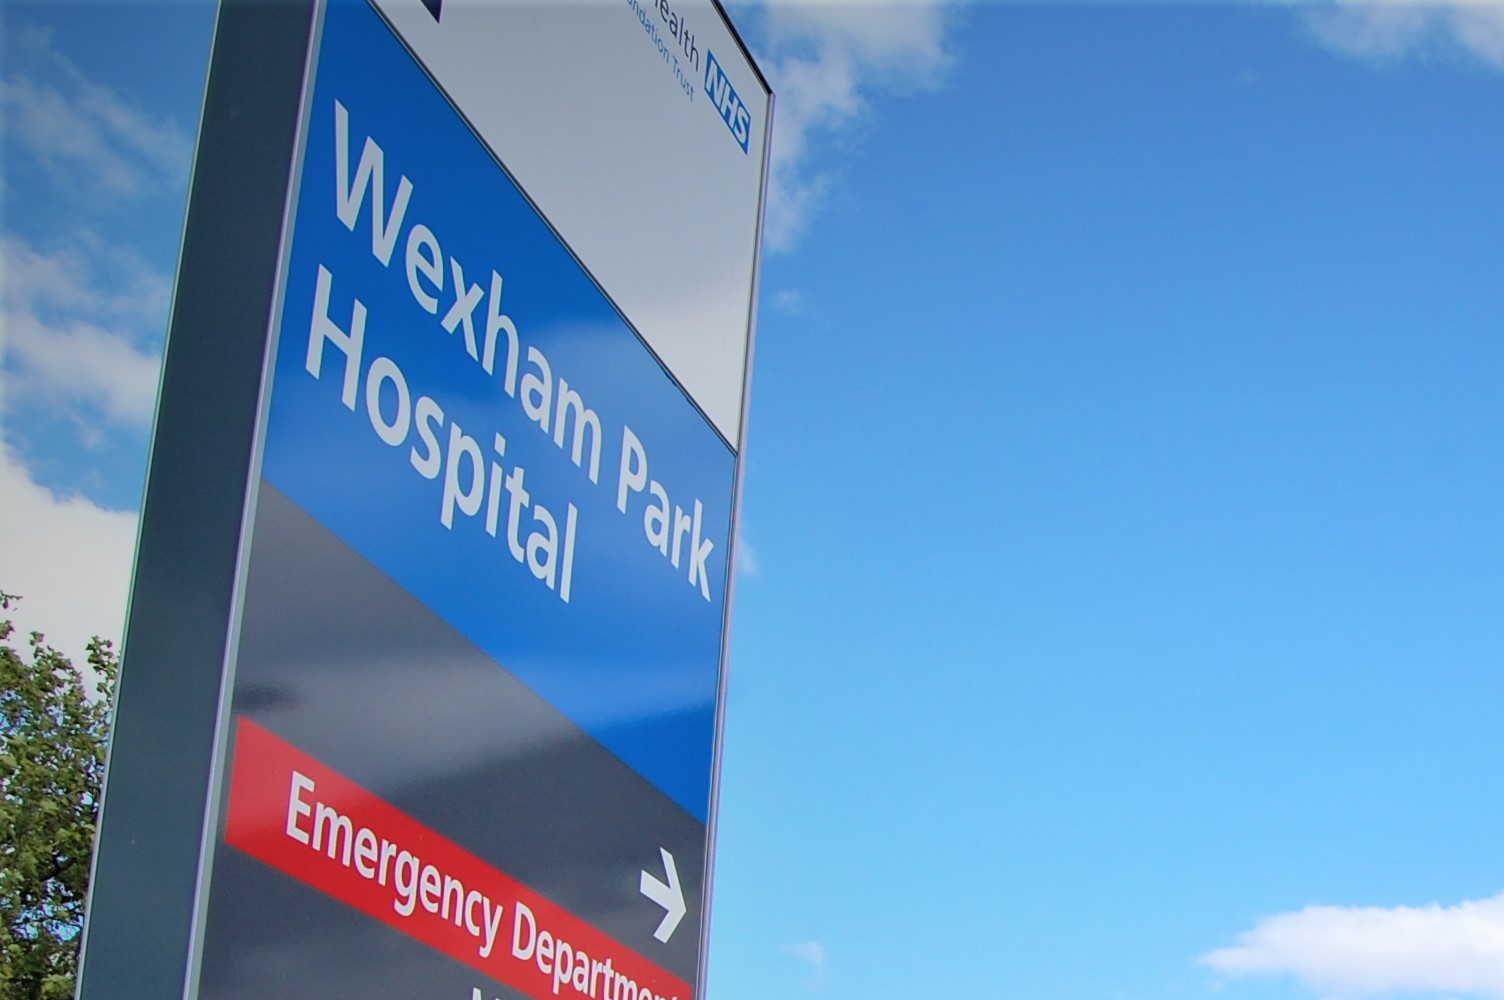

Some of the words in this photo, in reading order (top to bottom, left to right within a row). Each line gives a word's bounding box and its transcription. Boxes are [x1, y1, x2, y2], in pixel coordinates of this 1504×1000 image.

[655, 0, 700, 72] ealth
[673, 55, 694, 102] Trust
[707, 59, 749, 145] NHS
[335, 98, 602, 484] Wexham
[617, 425, 714, 602] Park
[305, 264, 577, 603] Hospital
[286, 770, 503, 957] Emergency
